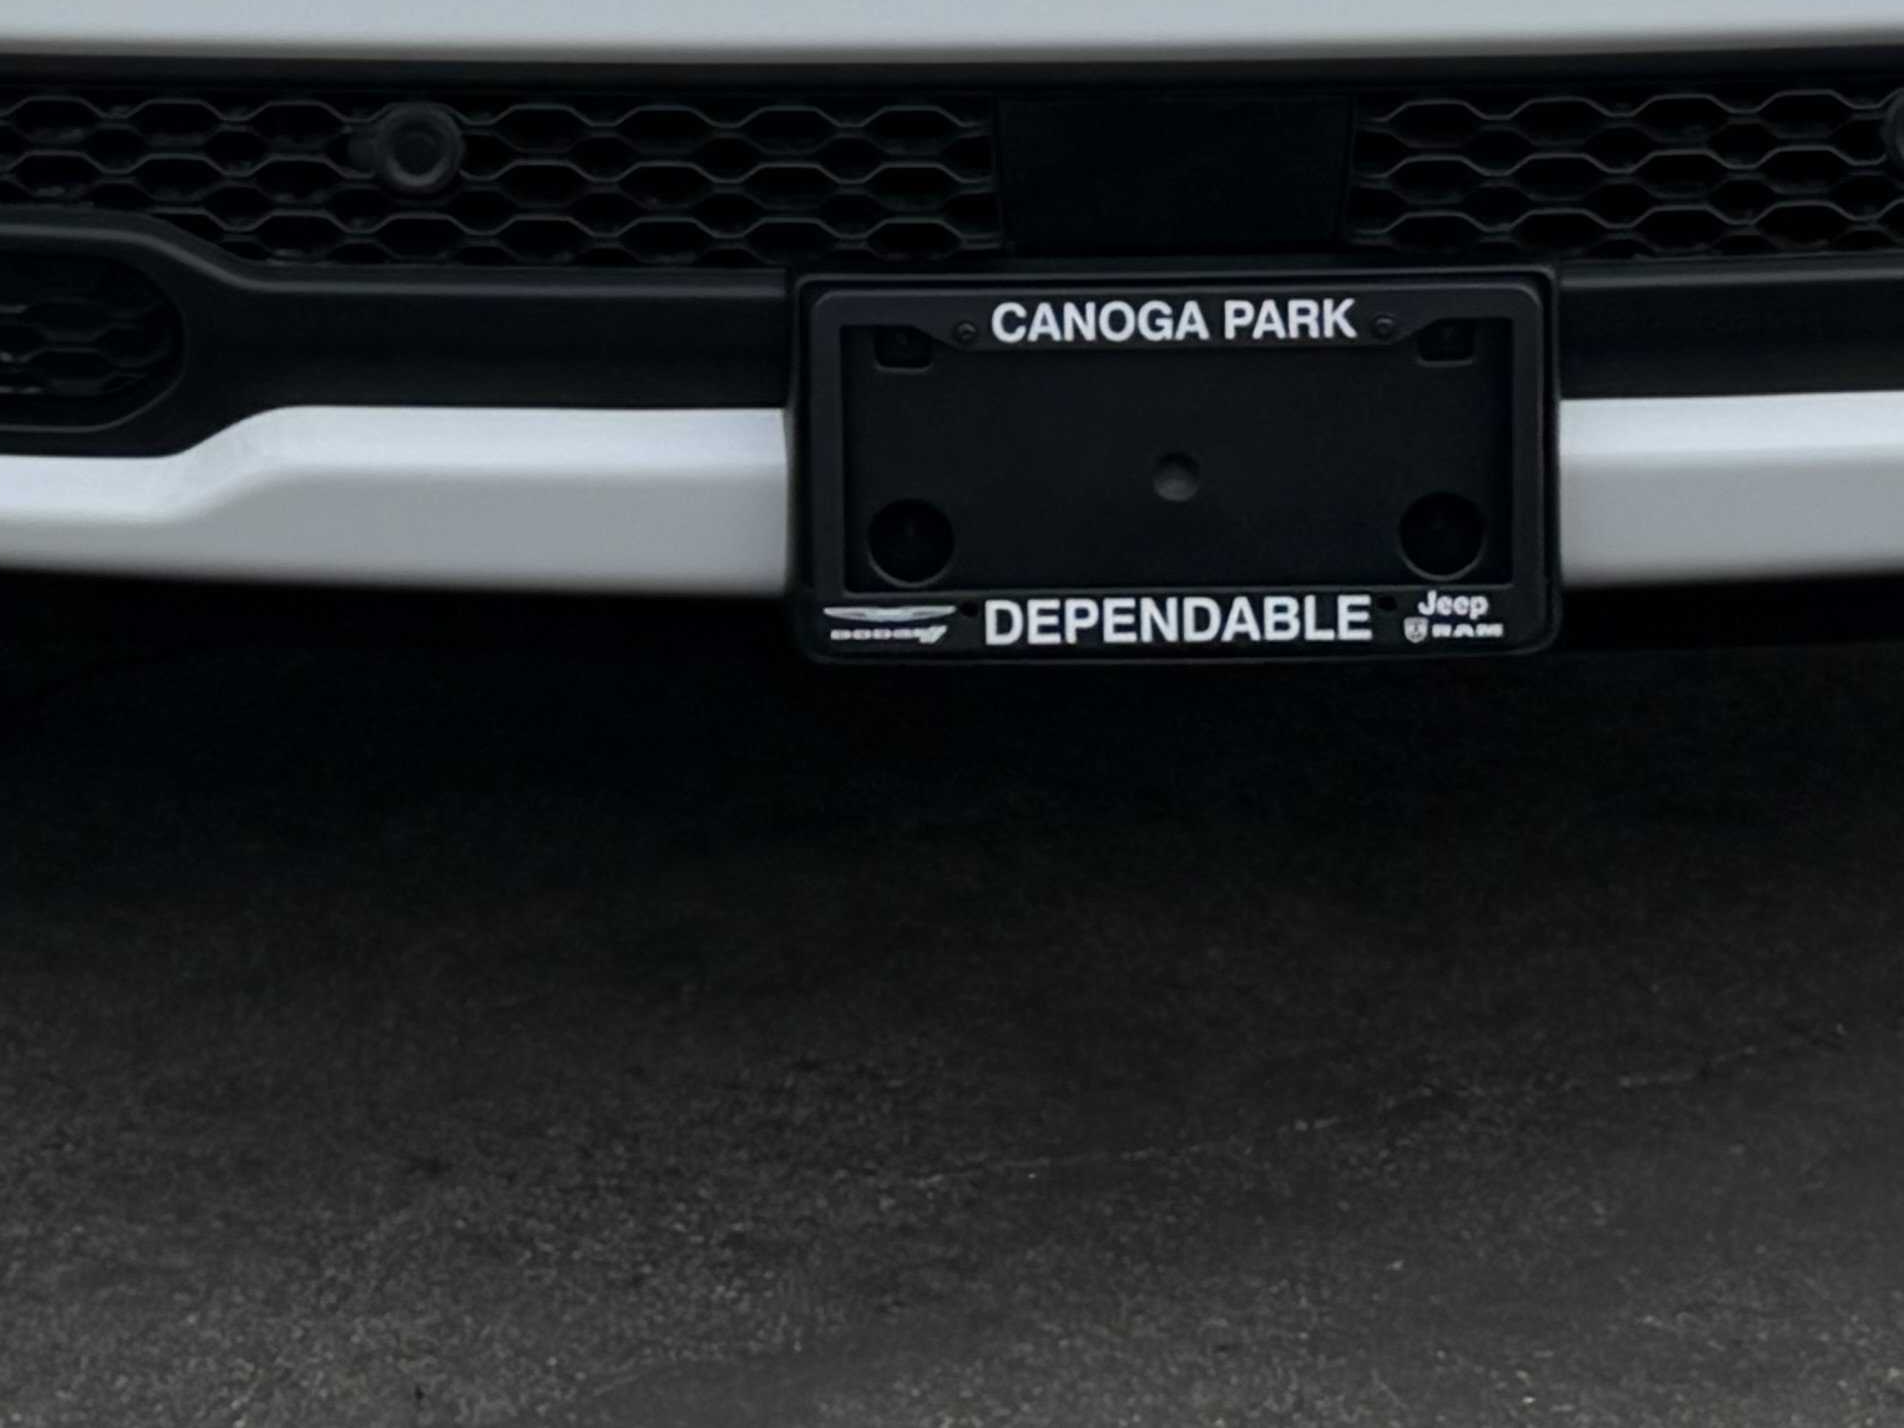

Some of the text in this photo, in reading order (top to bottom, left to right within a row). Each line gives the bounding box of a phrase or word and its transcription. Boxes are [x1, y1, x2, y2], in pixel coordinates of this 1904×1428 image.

[991, 298, 1358, 343] CANOGA PARK
[984, 594, 1374, 645] DEPENDABLE
[1417, 590, 1489, 621] Jeep
